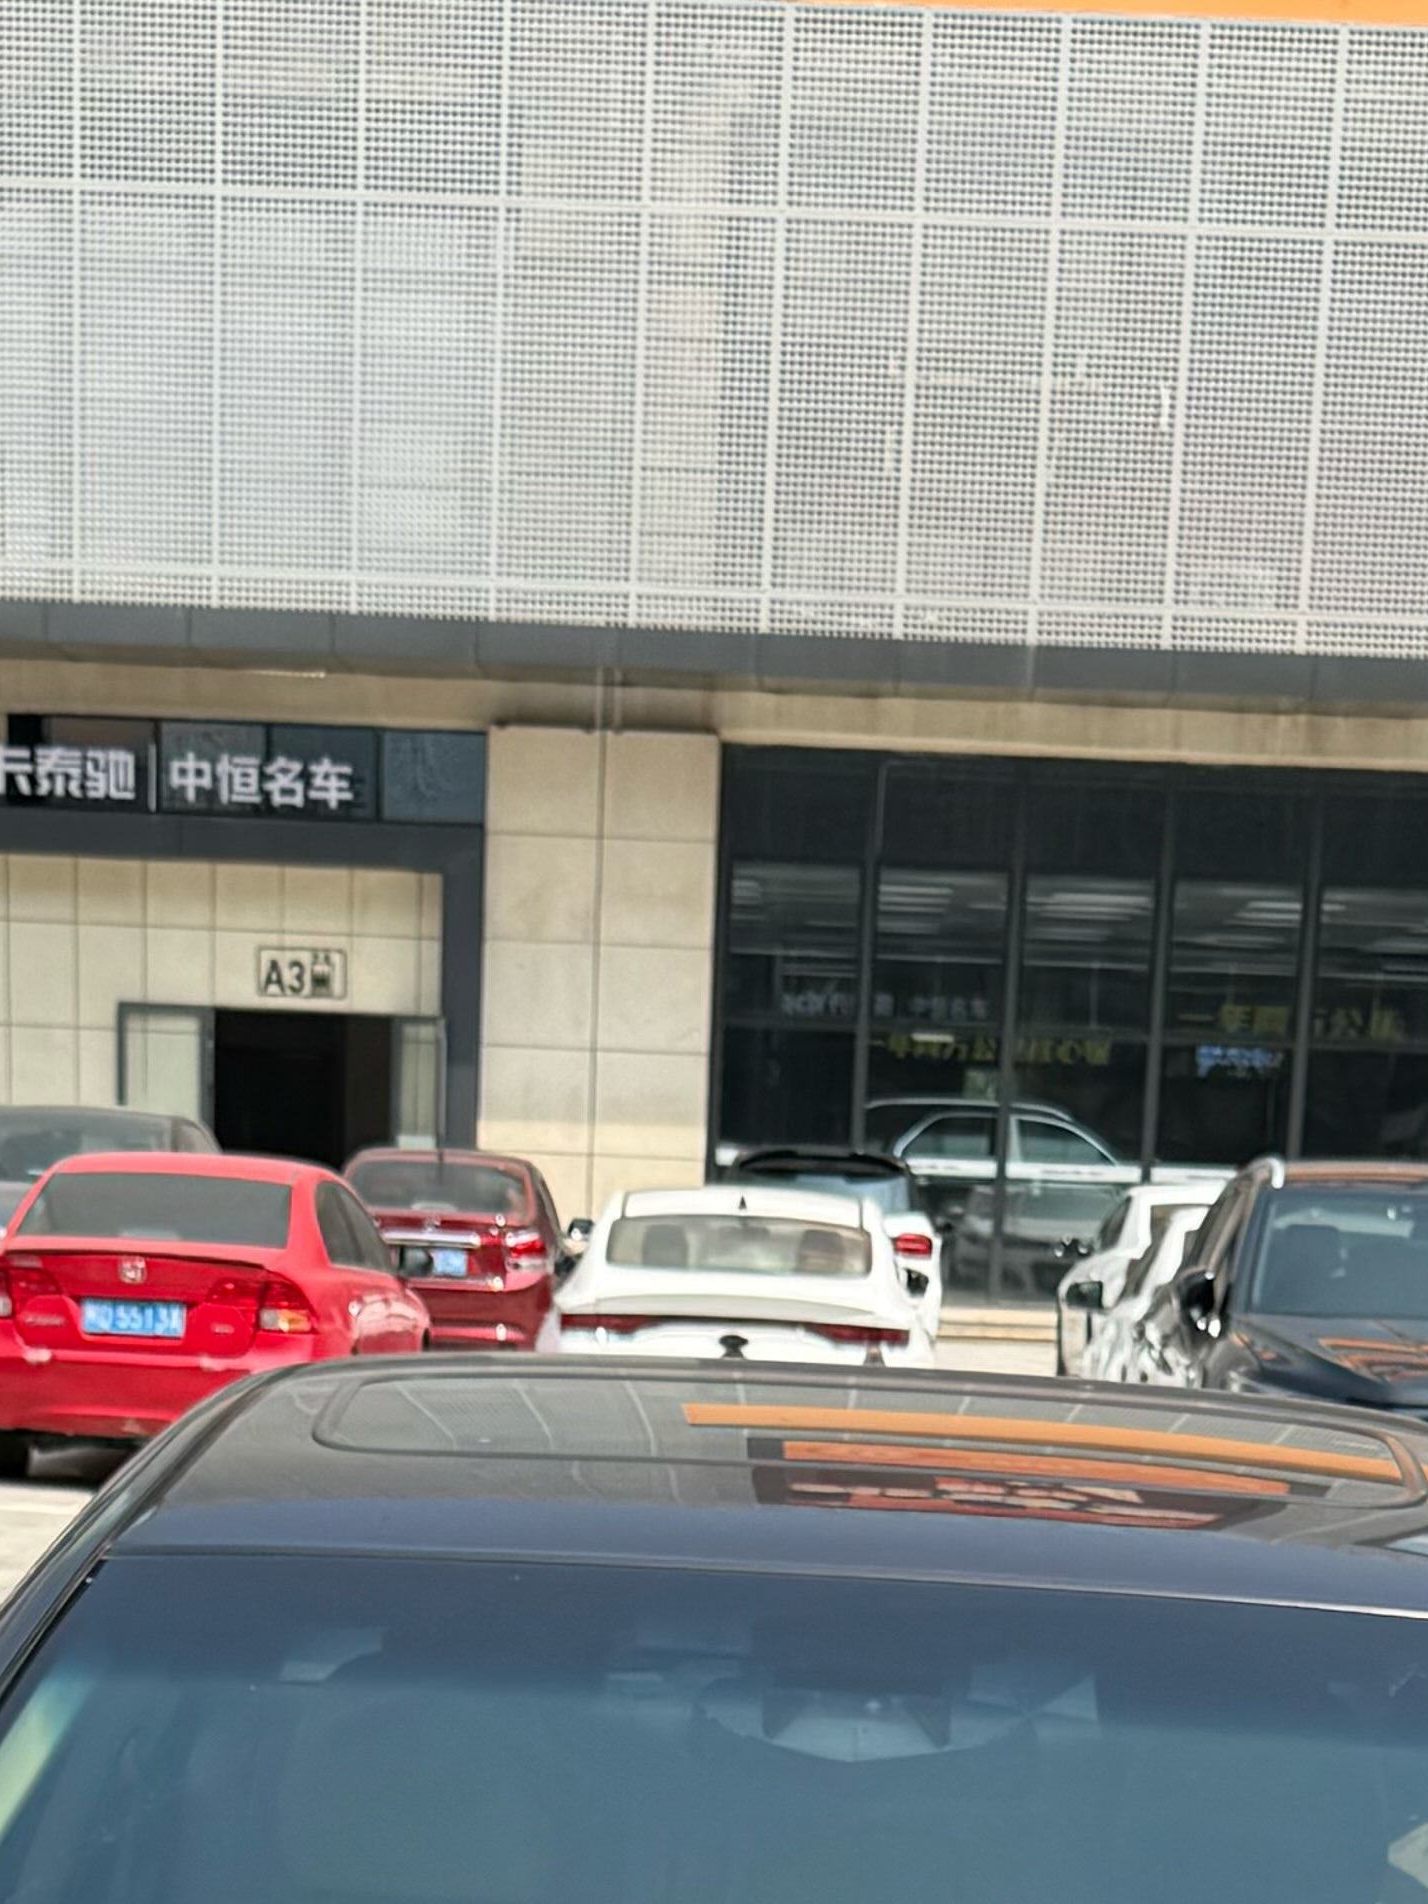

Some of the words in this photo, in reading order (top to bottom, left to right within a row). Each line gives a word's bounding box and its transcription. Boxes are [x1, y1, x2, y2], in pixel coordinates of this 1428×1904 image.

[169, 751, 354, 809] 中恒名车
[264, 959, 305, 994] A3
